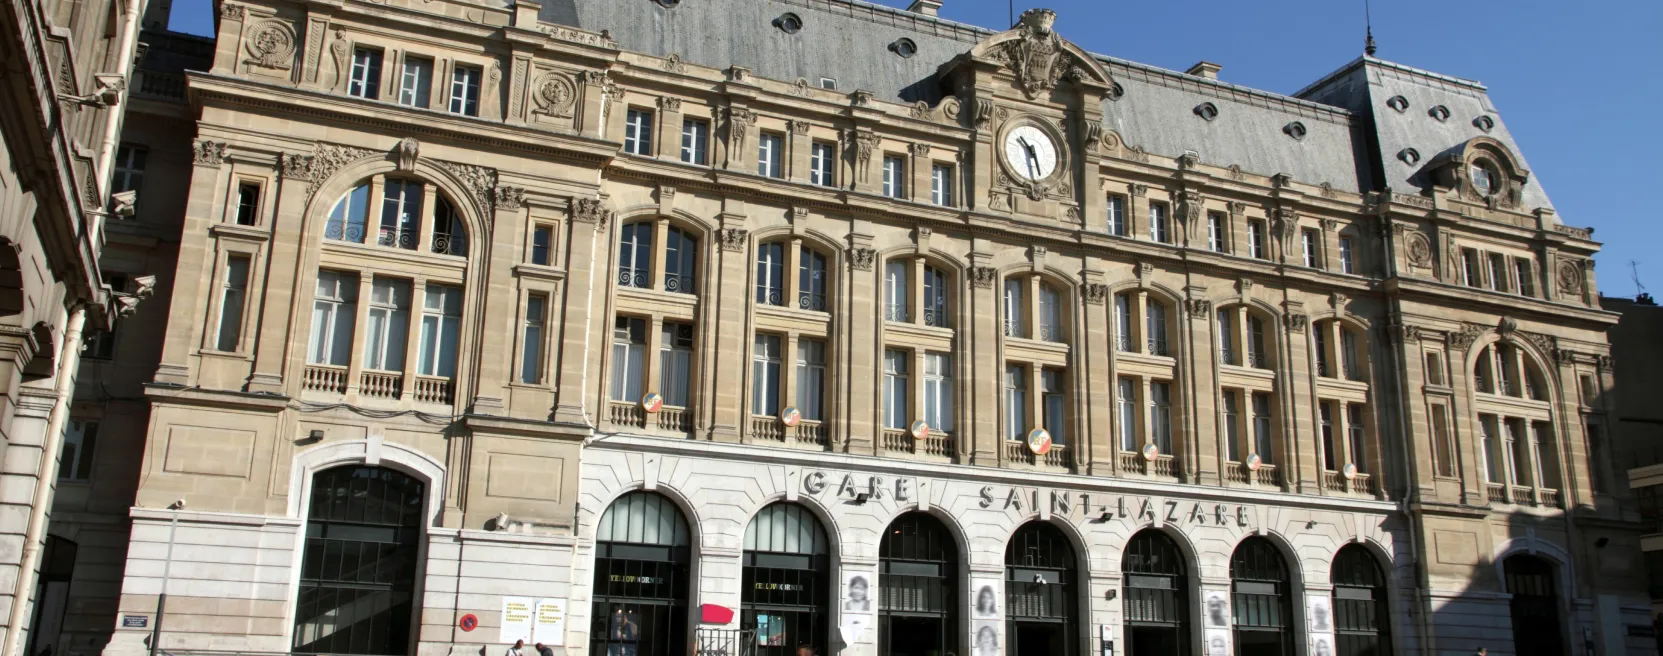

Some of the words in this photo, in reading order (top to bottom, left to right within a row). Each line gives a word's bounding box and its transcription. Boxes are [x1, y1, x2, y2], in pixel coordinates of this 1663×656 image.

[1034, 436, 1047, 445] RF
[804, 471, 911, 501] GARE
[979, 485, 1249, 526] SAINT-LAZARE
